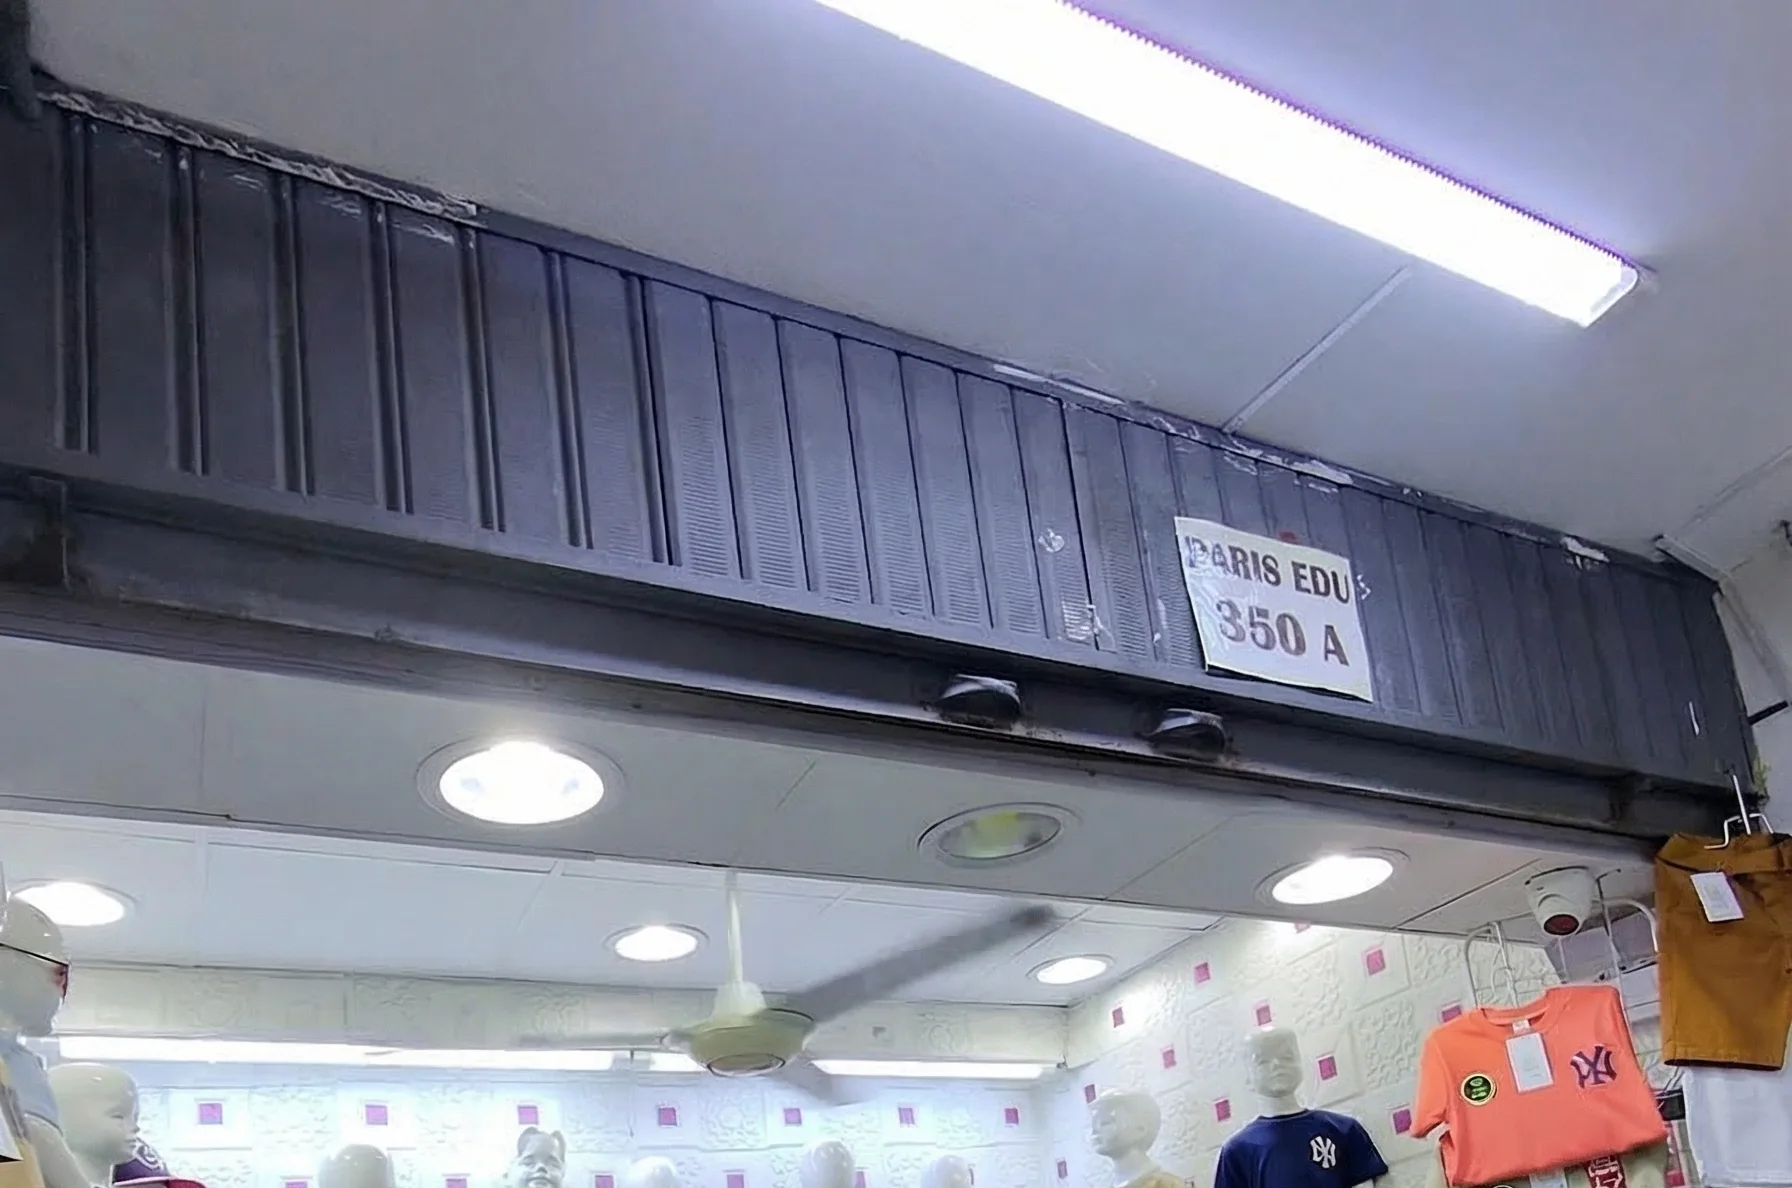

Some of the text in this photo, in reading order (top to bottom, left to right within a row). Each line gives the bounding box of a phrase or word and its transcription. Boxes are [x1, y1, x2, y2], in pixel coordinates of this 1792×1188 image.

[1185, 535, 1350, 605] PARIS EDU
[1216, 600, 1349, 667] 350 A
